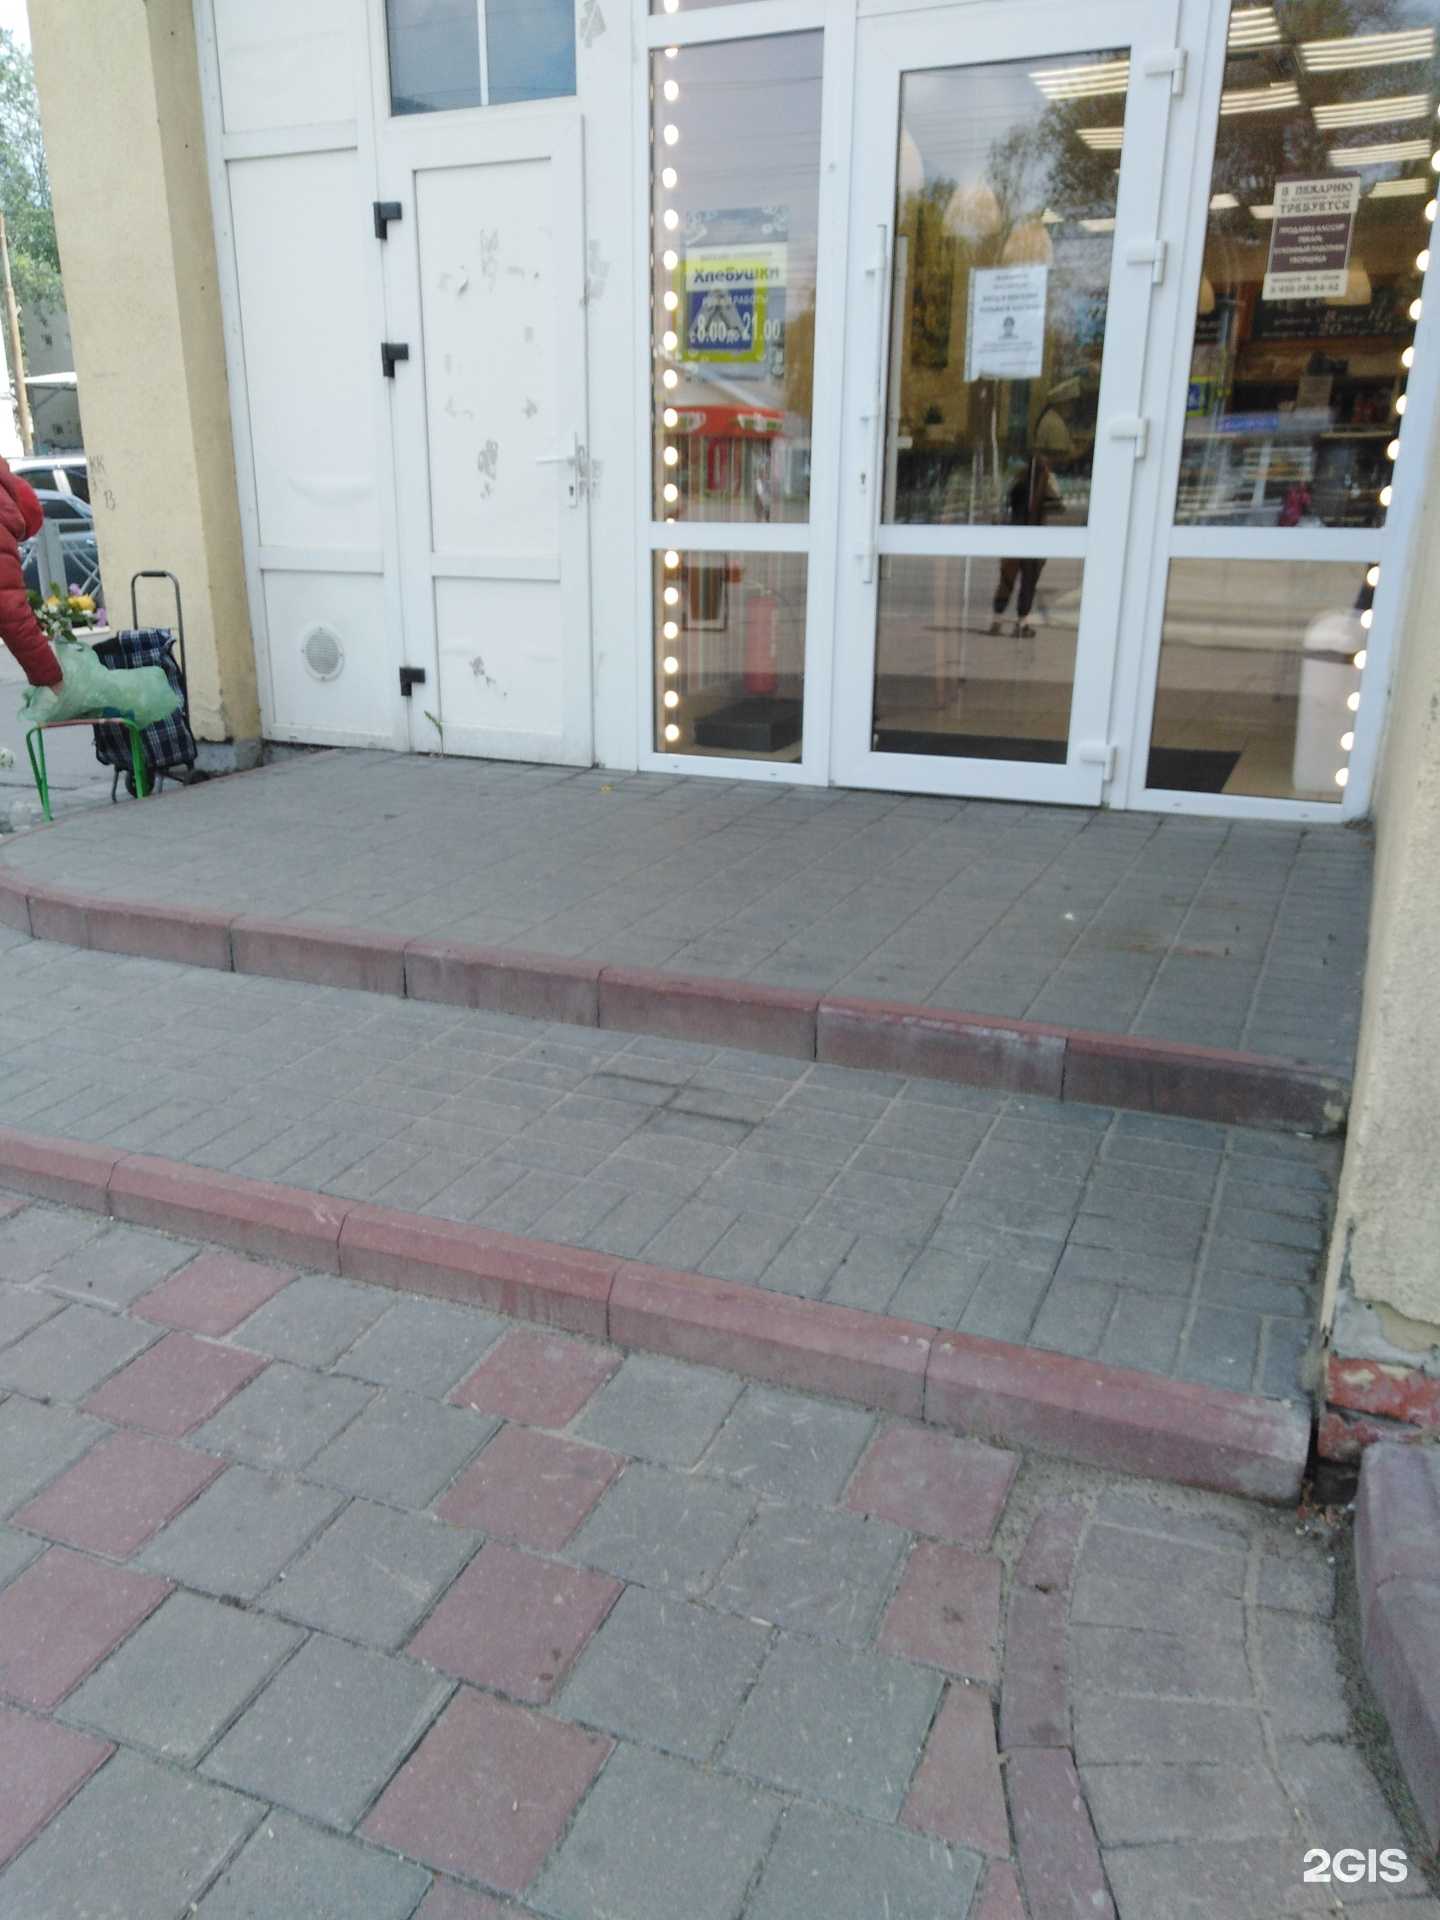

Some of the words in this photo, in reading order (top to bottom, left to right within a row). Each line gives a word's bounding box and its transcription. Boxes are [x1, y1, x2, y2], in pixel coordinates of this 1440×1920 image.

[1280, 199, 1350, 214] ТРЕБУЕТСЯ
[697, 313, 726, 343] 8.00
[742, 311, 780, 342] 21.00
